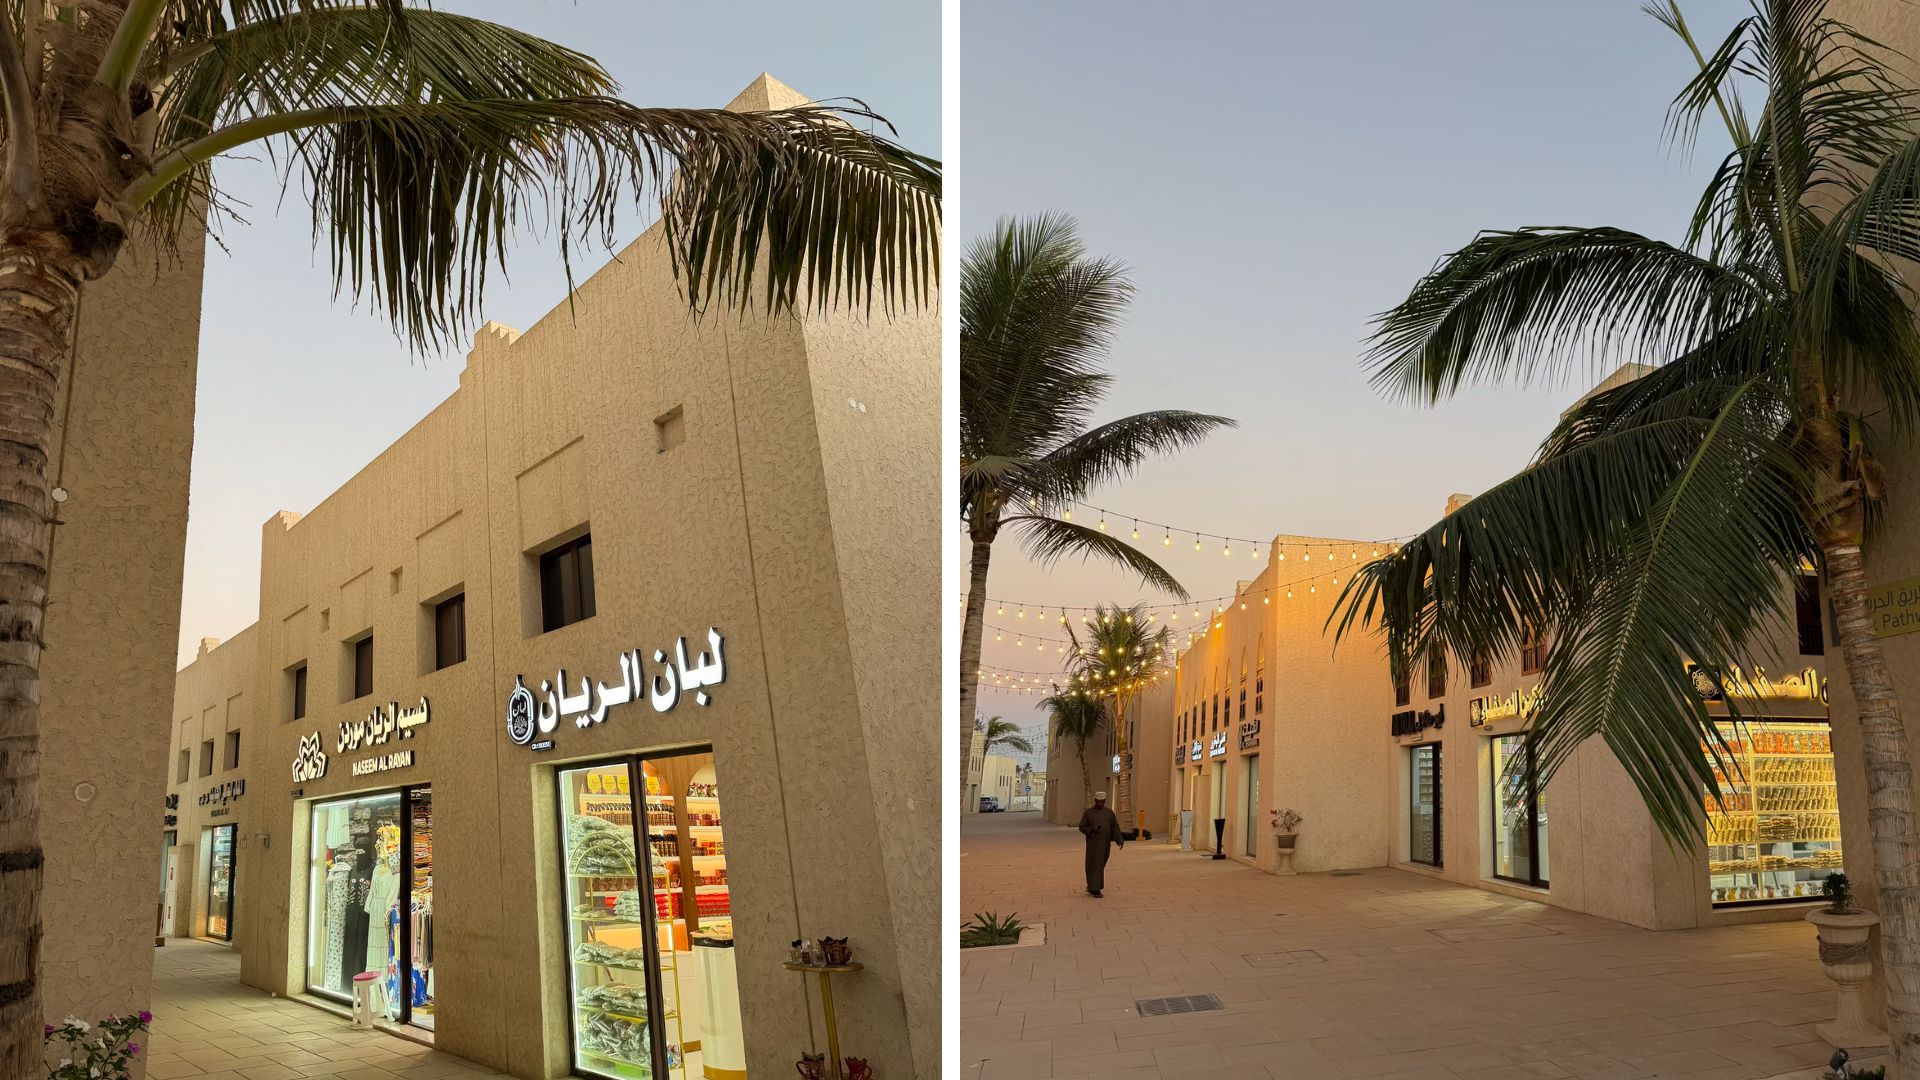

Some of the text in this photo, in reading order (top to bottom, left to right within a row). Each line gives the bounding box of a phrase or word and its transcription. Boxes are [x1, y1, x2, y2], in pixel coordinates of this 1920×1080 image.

[538, 627, 725, 733] لبان الريان
[366, 702, 396, 746] الريان
[397, 696, 429, 741] نسيم
[352, 750, 411, 777] NASEEM AL RAYAN
